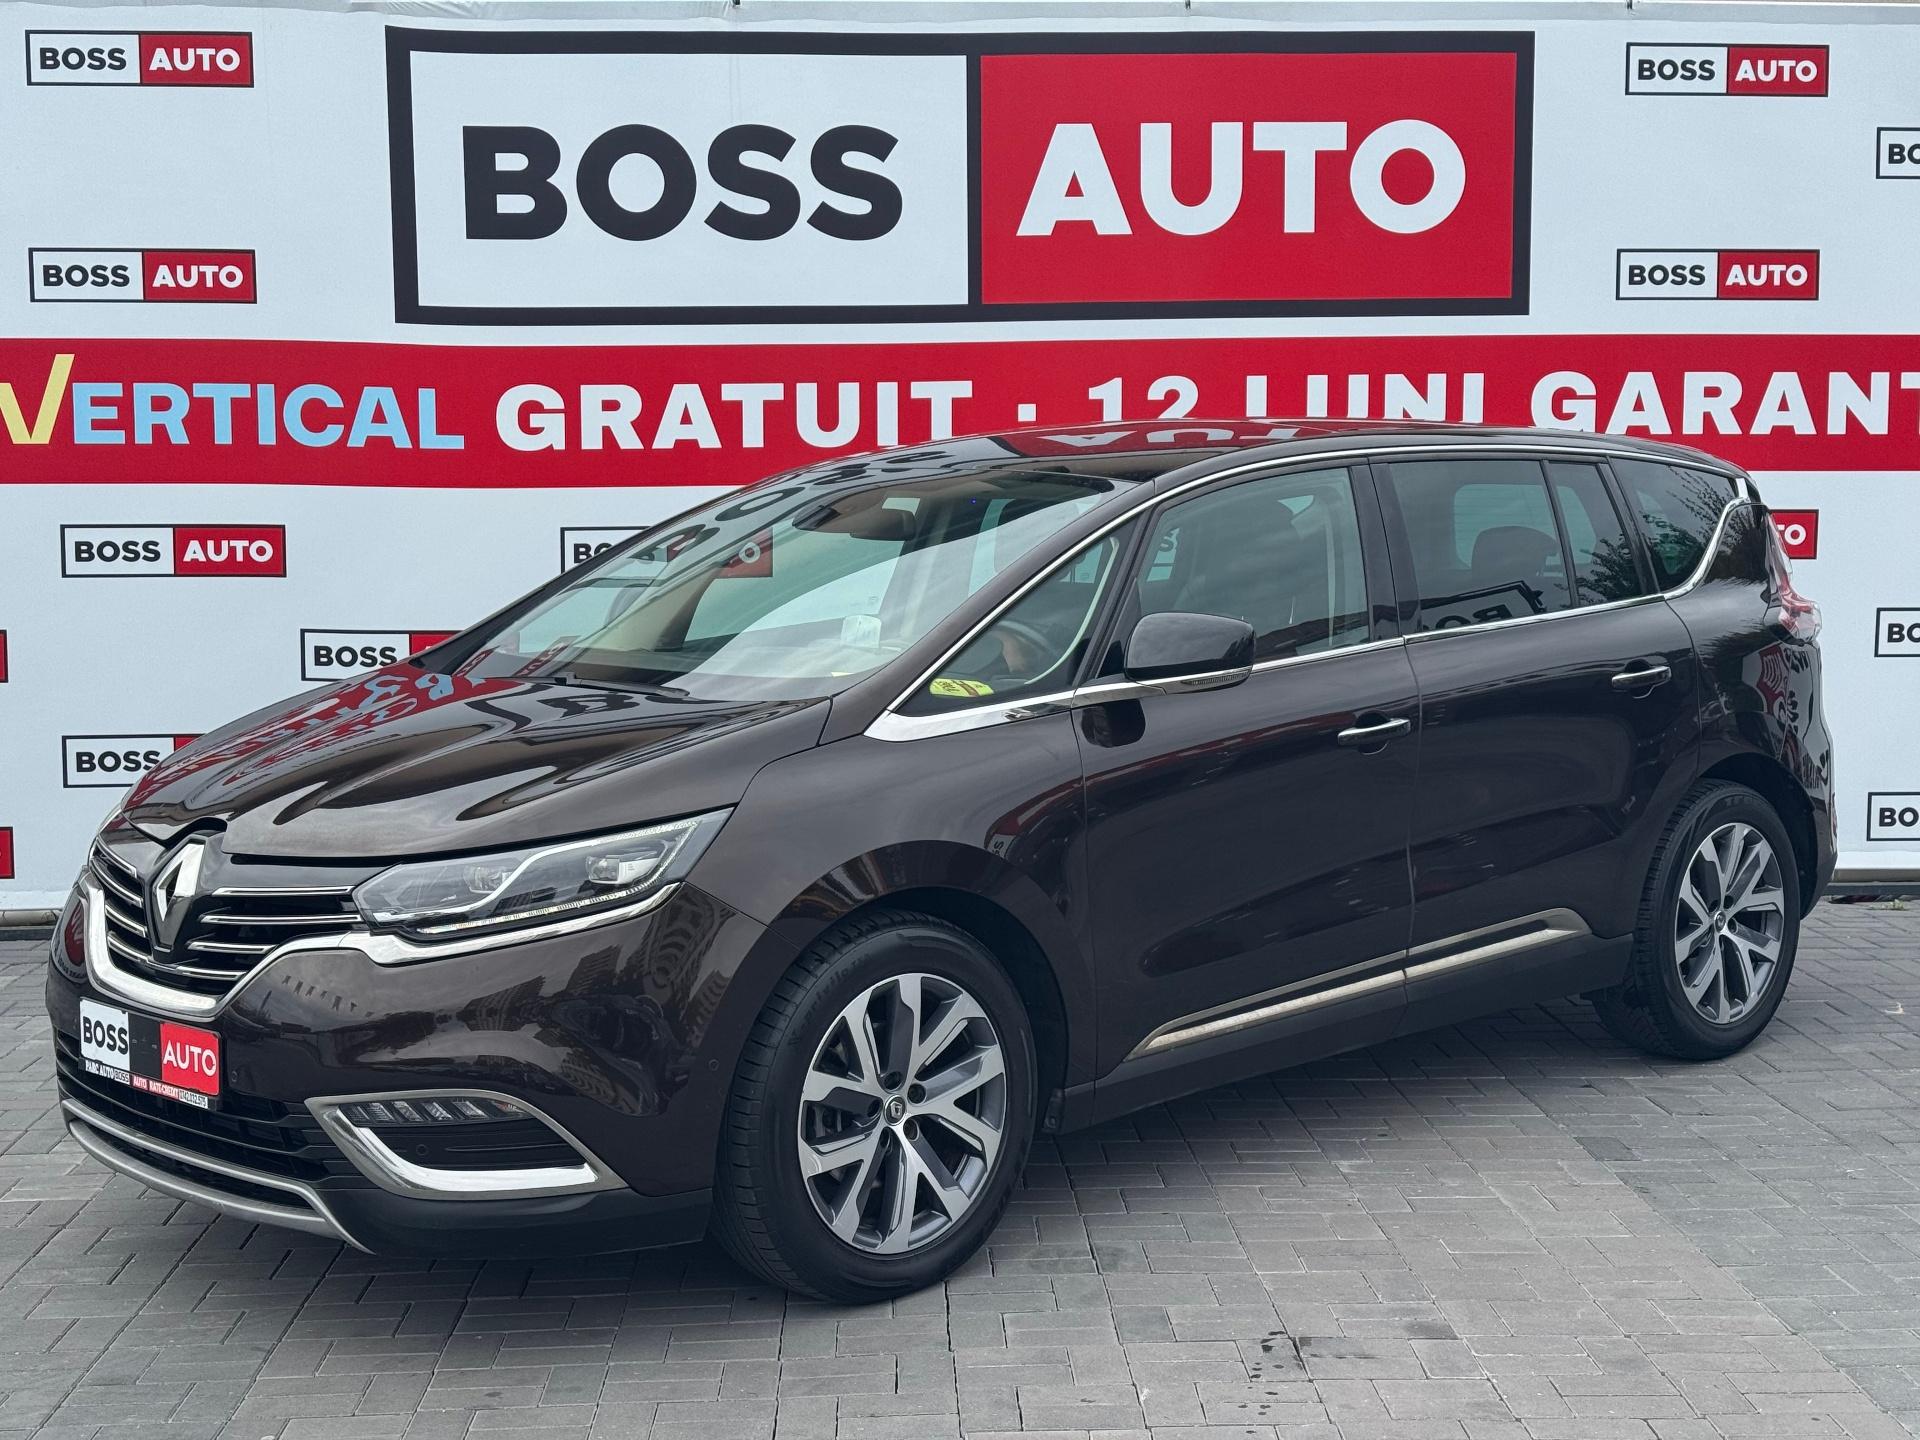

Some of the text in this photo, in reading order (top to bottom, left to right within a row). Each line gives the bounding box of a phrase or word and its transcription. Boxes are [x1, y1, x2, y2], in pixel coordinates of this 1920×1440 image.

[39, 47, 240, 72] BOSS AUTO
[1637, 60, 1818, 83] BOSS AUTO
[463, 119, 1466, 241] BOSS AUTO
[42, 265, 244, 288] BOSS AUTO
[1628, 265, 1808, 287] BOSS AUTO
[0, 354, 464, 449] VERTICAL
[496, 380, 973, 450] GRATUIT
[1089, 375, 1199, 420] 12
[74, 540, 274, 563] BOSS AUTO
[314, 646, 397, 667] BOSS
[76, 750, 160, 772] BOSS
[83, 1016, 217, 1076] BOSS AUTO
